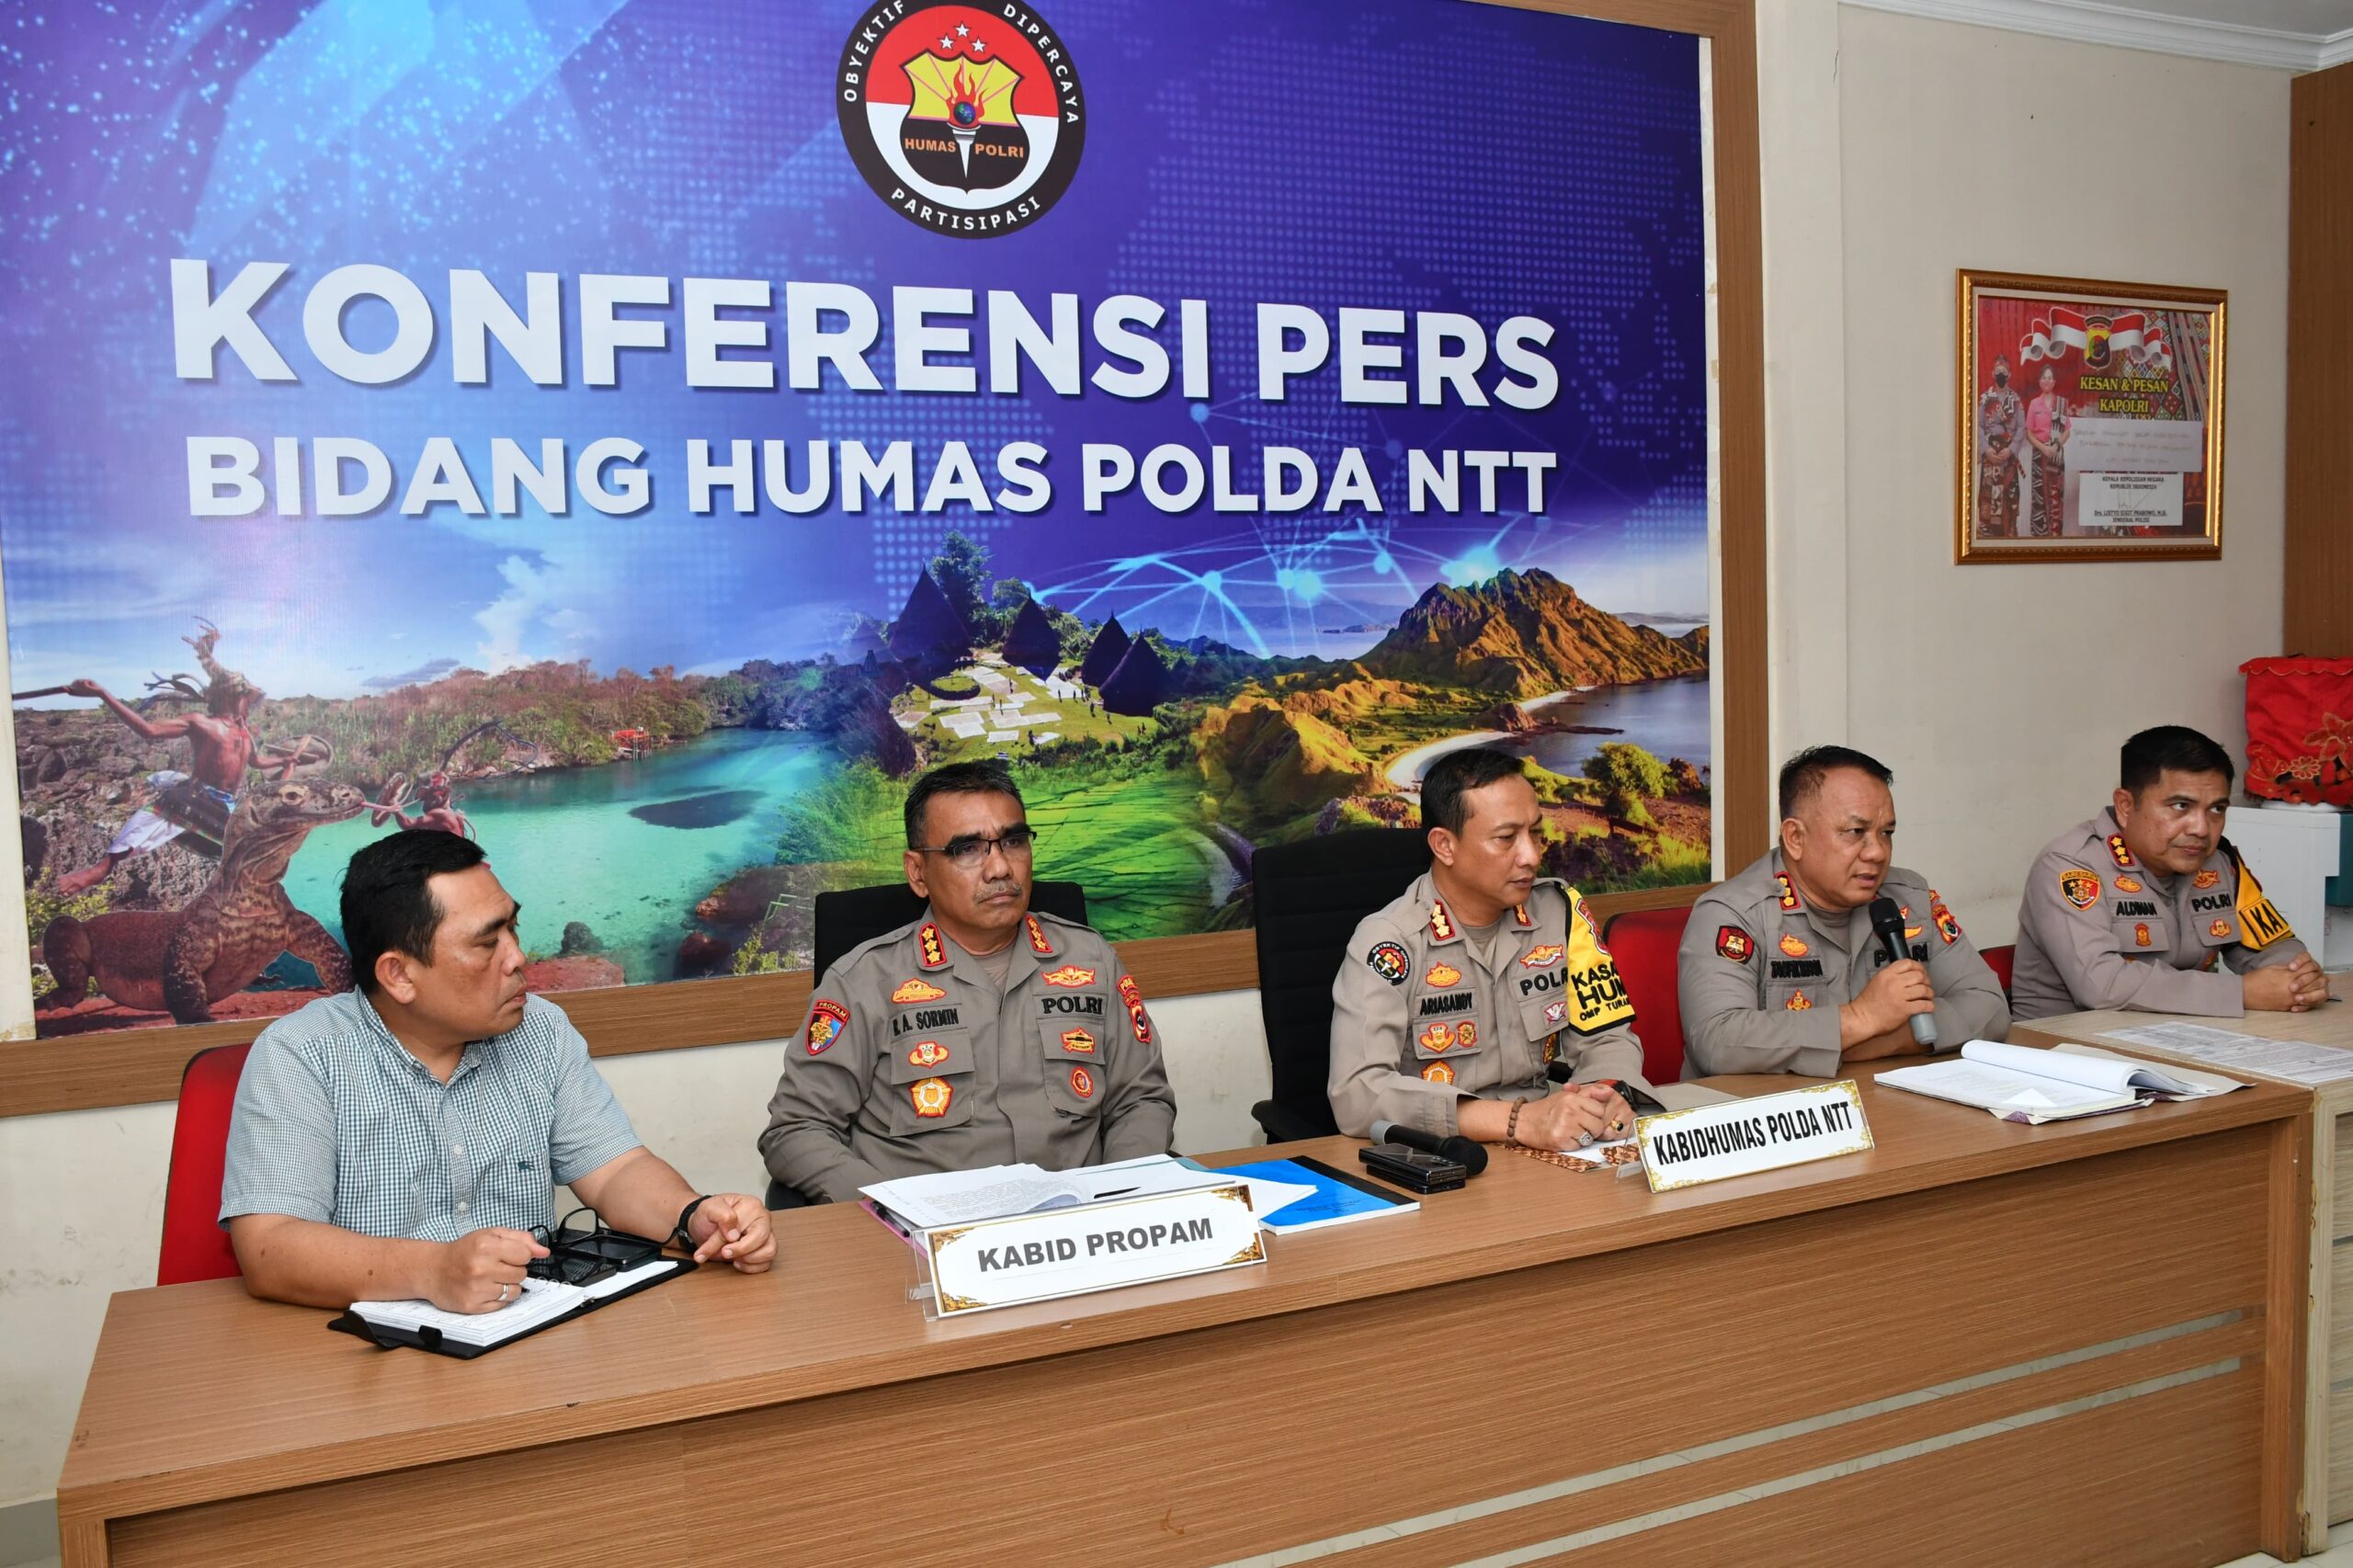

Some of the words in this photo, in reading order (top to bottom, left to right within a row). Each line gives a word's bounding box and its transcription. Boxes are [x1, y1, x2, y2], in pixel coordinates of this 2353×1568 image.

[844, 0, 905, 102] OBYEKTIF
[1004, 3, 1079, 123] DIPERCAYA
[904, 138, 957, 153] HUMAS
[974, 143, 1024, 157] POLRI
[891, 187, 1040, 231] PARTISIPASI
[171, 258, 1211, 399] KONFERENSI
[1256, 302, 1560, 410] PERS
[2080, 376, 2119, 391] KESAN
[2120, 378, 2131, 392] &
[2132, 379, 2169, 392] PESAN
[2099, 398, 2149, 413] KAPOLRI
[187, 437, 650, 516] BIDANG
[687, 438, 1051, 513] HUMAS
[1082, 443, 1382, 513] POLDA
[1407, 449, 1558, 513] NTT
[2191, 893, 2232, 912] POLRI
[1874, 941, 1928, 968] PRI
[819, 1002, 847, 1018] PROPAM
[1040, 995, 1103, 1015] POLRI
[1579, 1006, 1600, 1021] OMP
[915, 1008, 960, 1030] SORMIN
[1654, 1117, 1767, 1166] KABIDHUMAS
[1765, 1108, 1823, 1143] POLDA
[1822, 1101, 1853, 1134] NTT
[977, 1237, 1077, 1272] KABID
[1086, 1218, 1213, 1256] PROPAM
